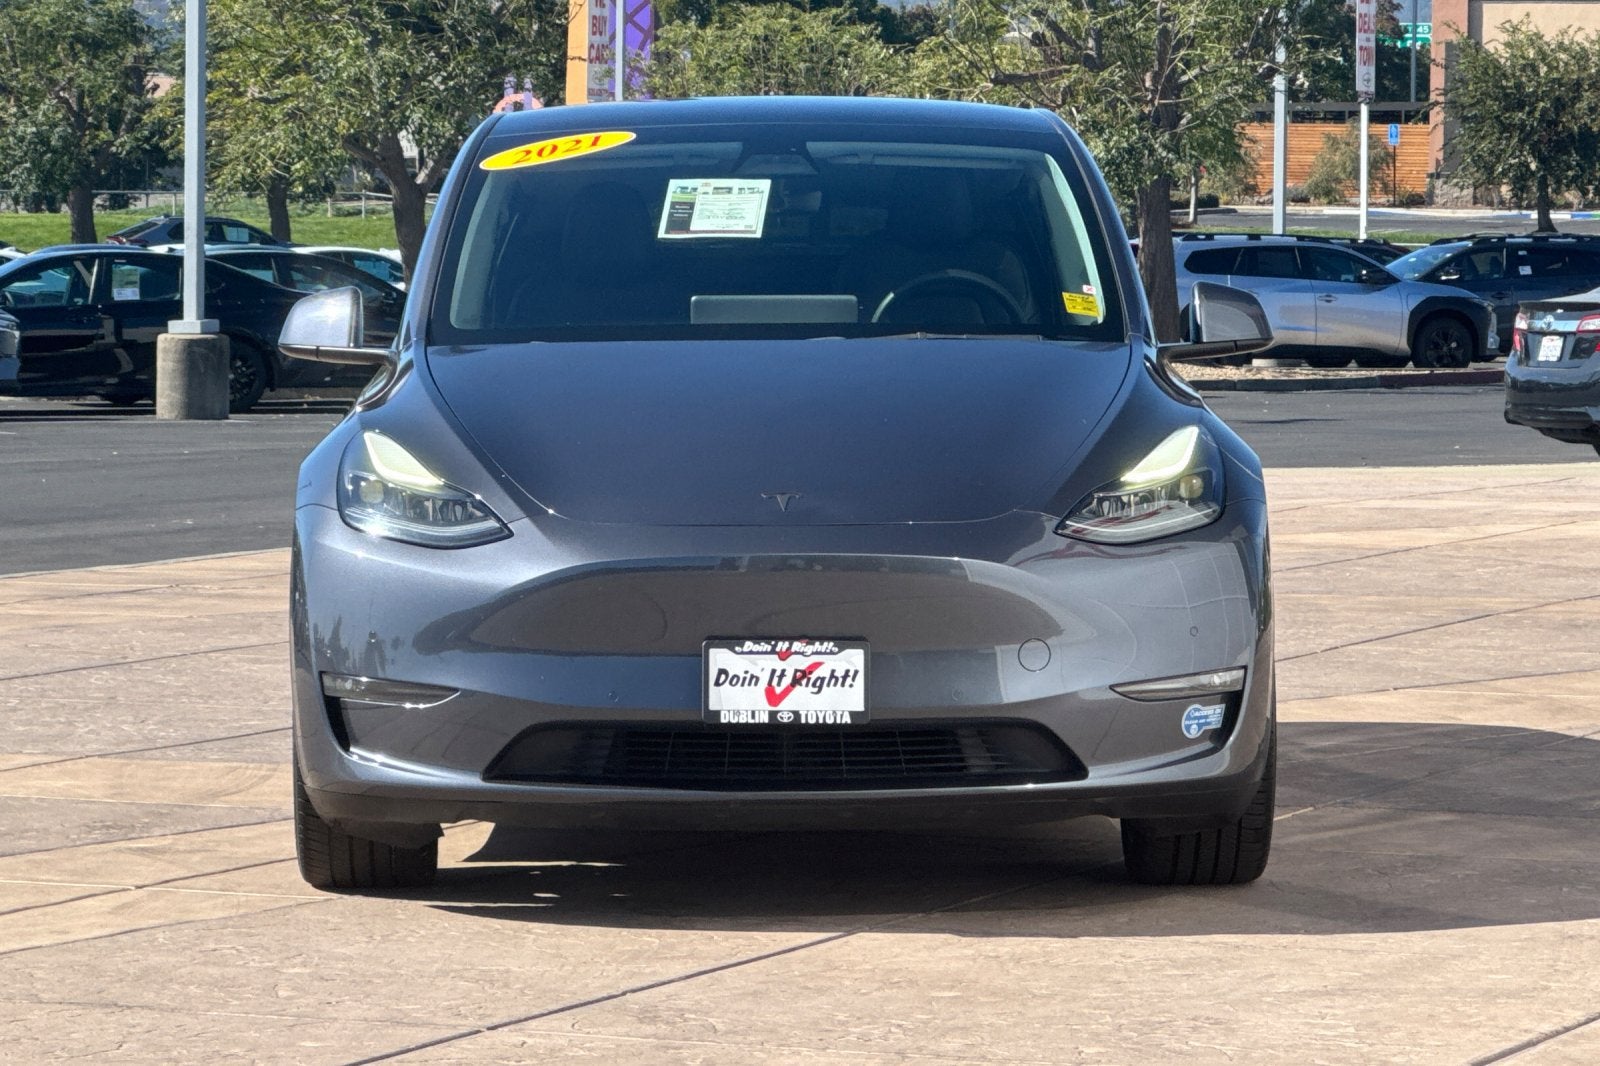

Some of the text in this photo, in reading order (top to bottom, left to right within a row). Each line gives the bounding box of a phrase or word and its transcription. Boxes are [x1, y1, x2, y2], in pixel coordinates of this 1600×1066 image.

[591, 15, 608, 36] BUY
[1417, 25, 1429, 34] 45
[512, 135, 602, 164] 2021
[743, 641, 834, 657] Doin' It Right!
[714, 668, 859, 695] Doin' It Right!
[720, 710, 851, 724] DUBLIN TOYOTA
